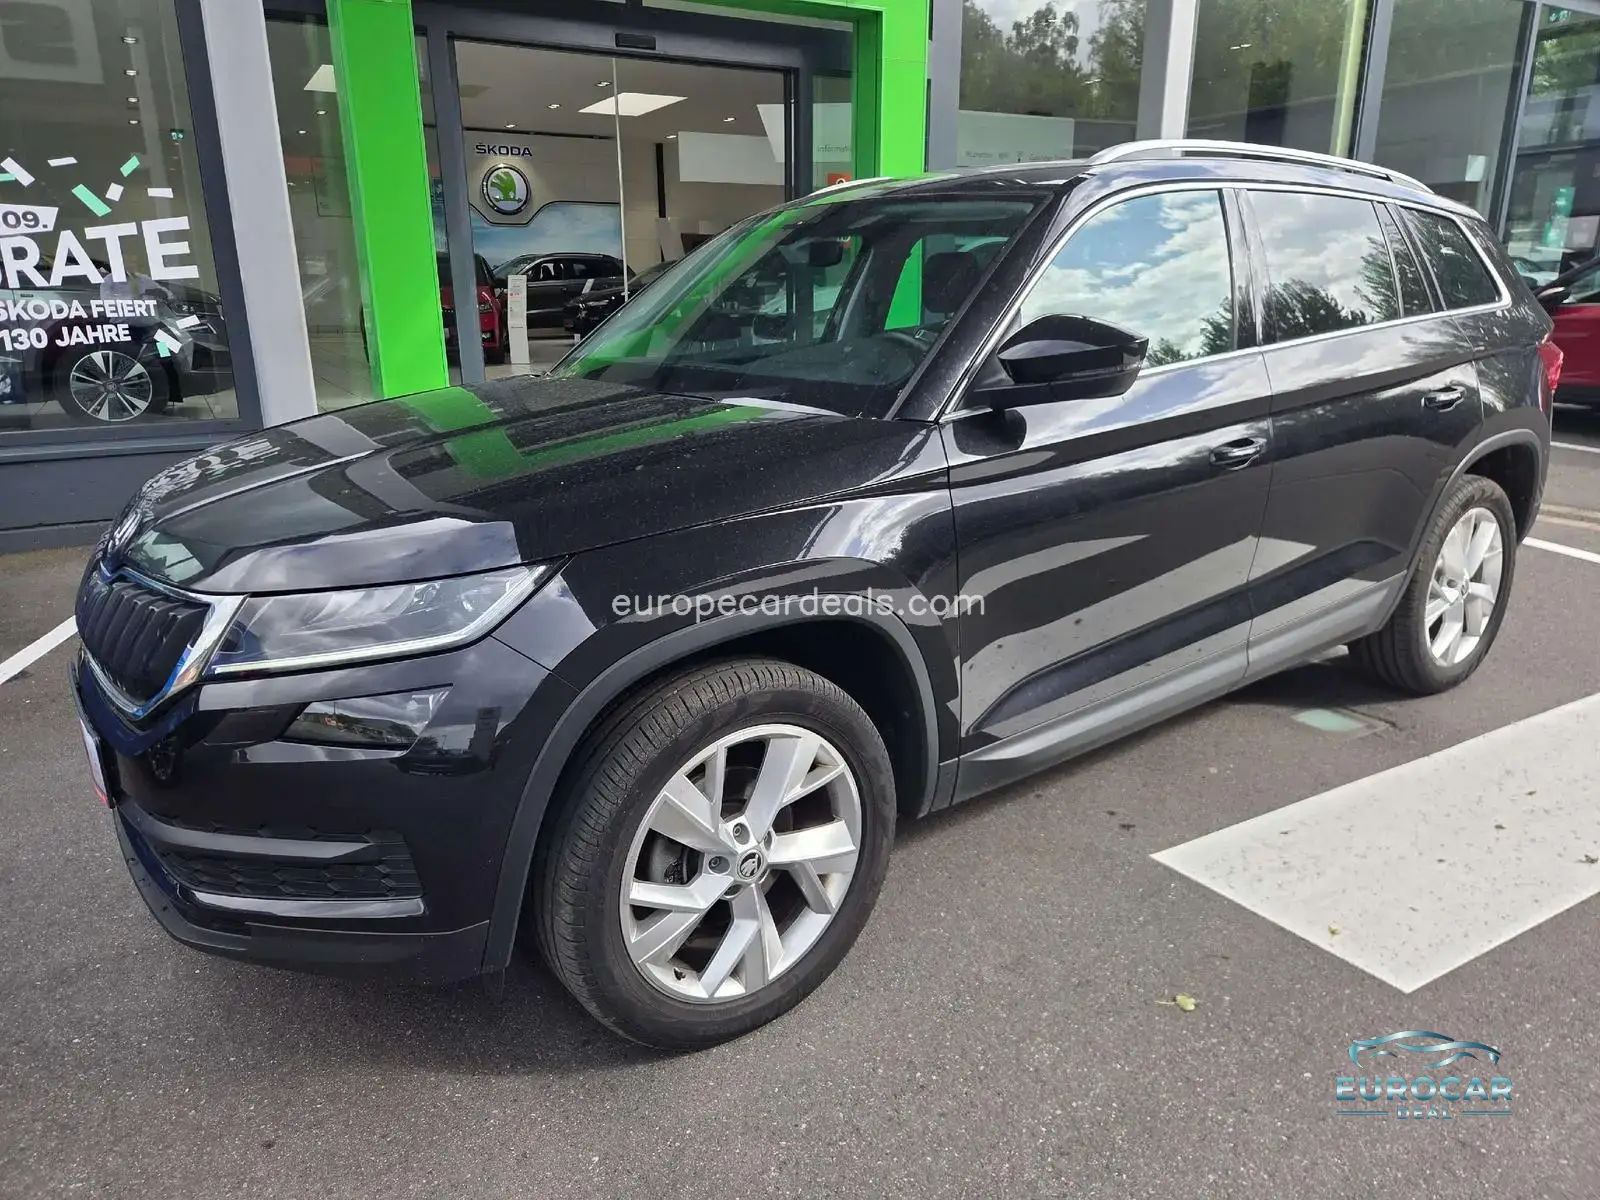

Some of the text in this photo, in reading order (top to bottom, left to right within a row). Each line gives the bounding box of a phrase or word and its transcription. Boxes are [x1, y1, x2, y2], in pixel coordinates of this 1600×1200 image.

[475, 142, 533, 156] ŠKODA
[0, 215, 200, 289] RATE
[89, 299, 158, 318] FEIERT
[0, 323, 132, 351] 130 JAHRE
